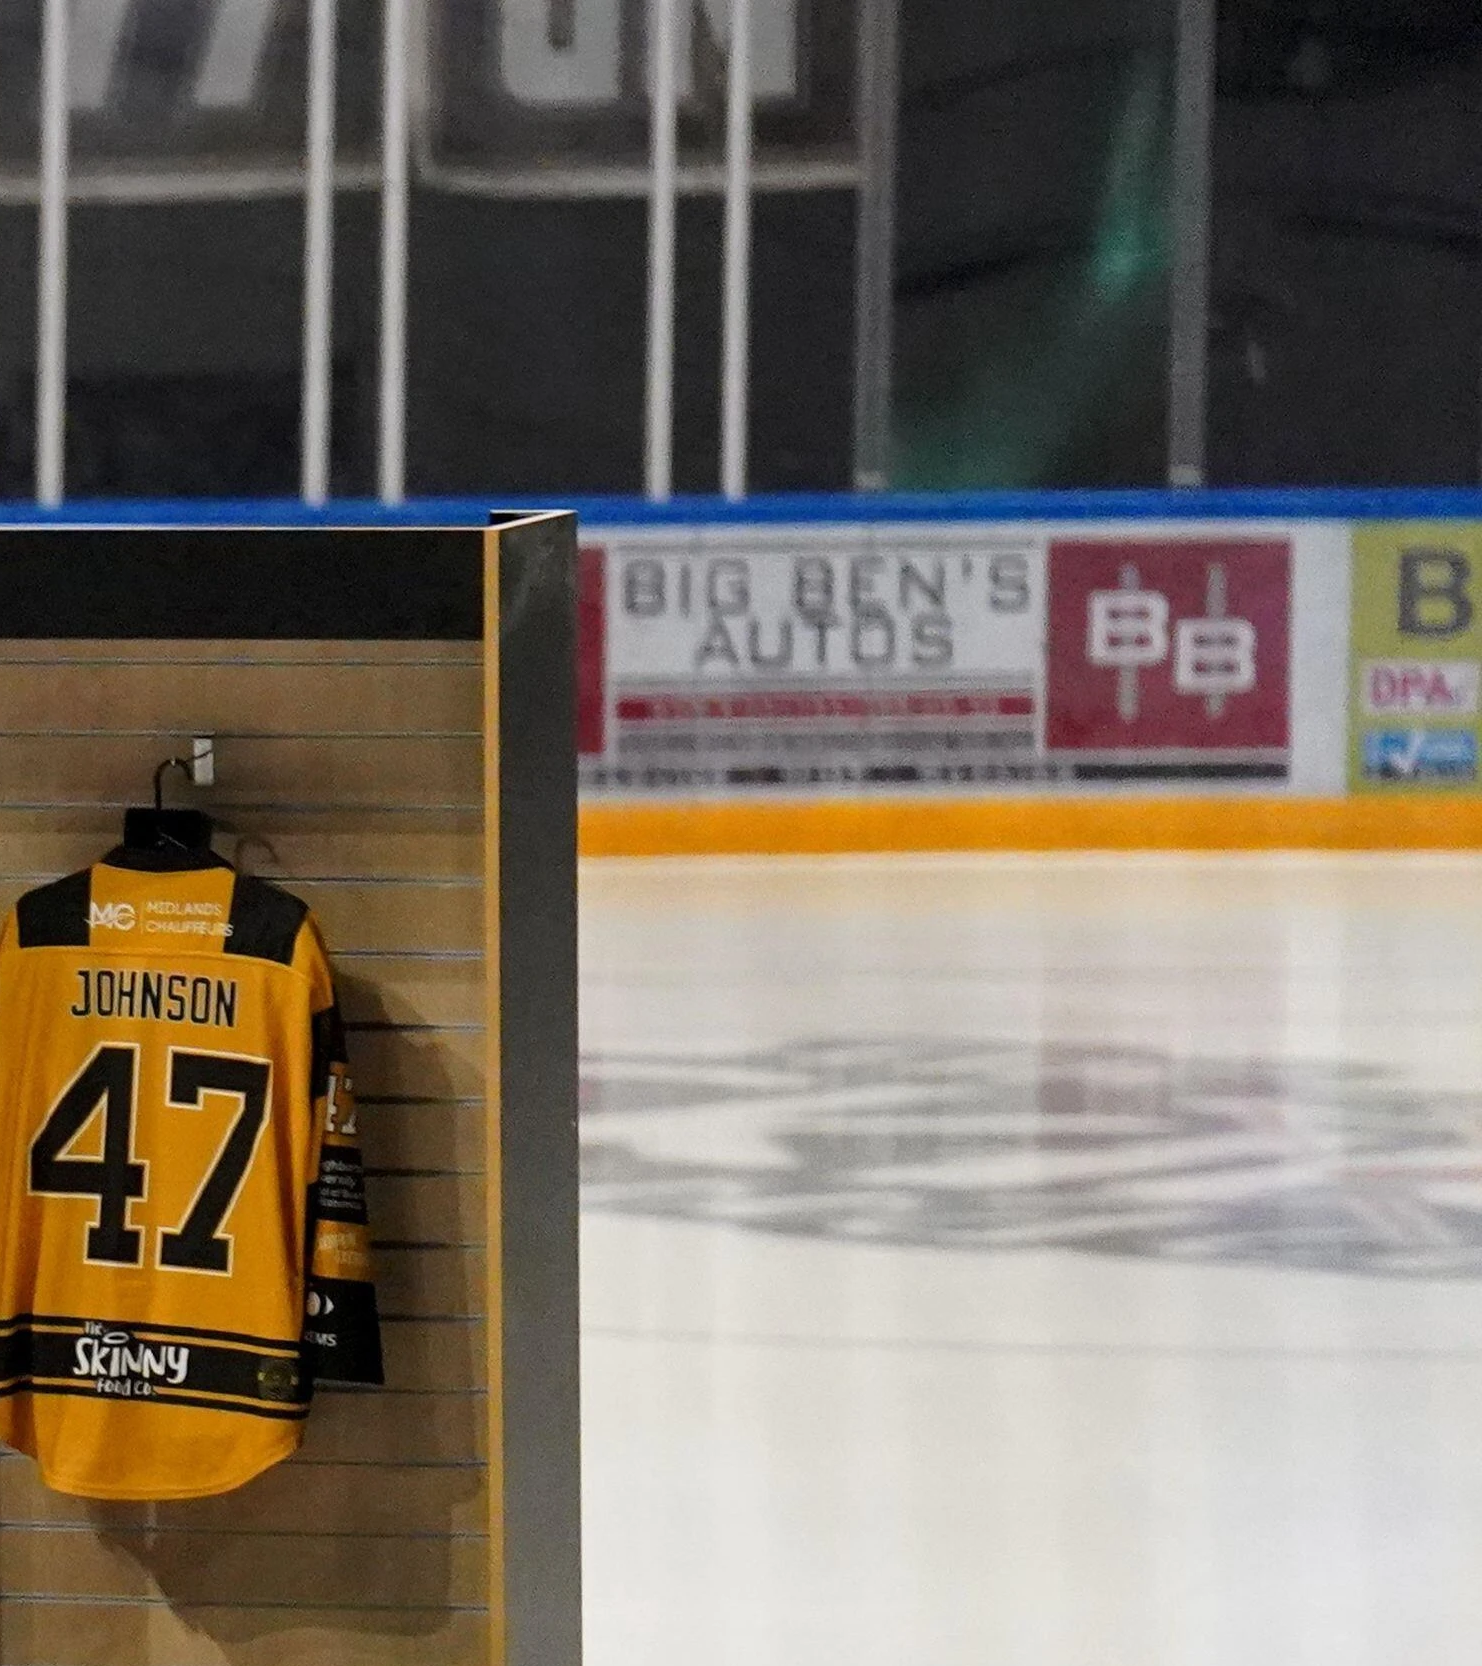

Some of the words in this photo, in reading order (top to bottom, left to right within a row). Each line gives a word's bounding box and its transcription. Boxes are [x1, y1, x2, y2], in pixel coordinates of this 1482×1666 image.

[621, 556, 750, 620] BIG
[793, 553, 1034, 621] BEN'S
[692, 609, 956, 672] AUTOS
[70, 969, 238, 1028] JOHNSON
[26, 1040, 274, 1278] 47
[72, 1336, 190, 1385] SKINNY
